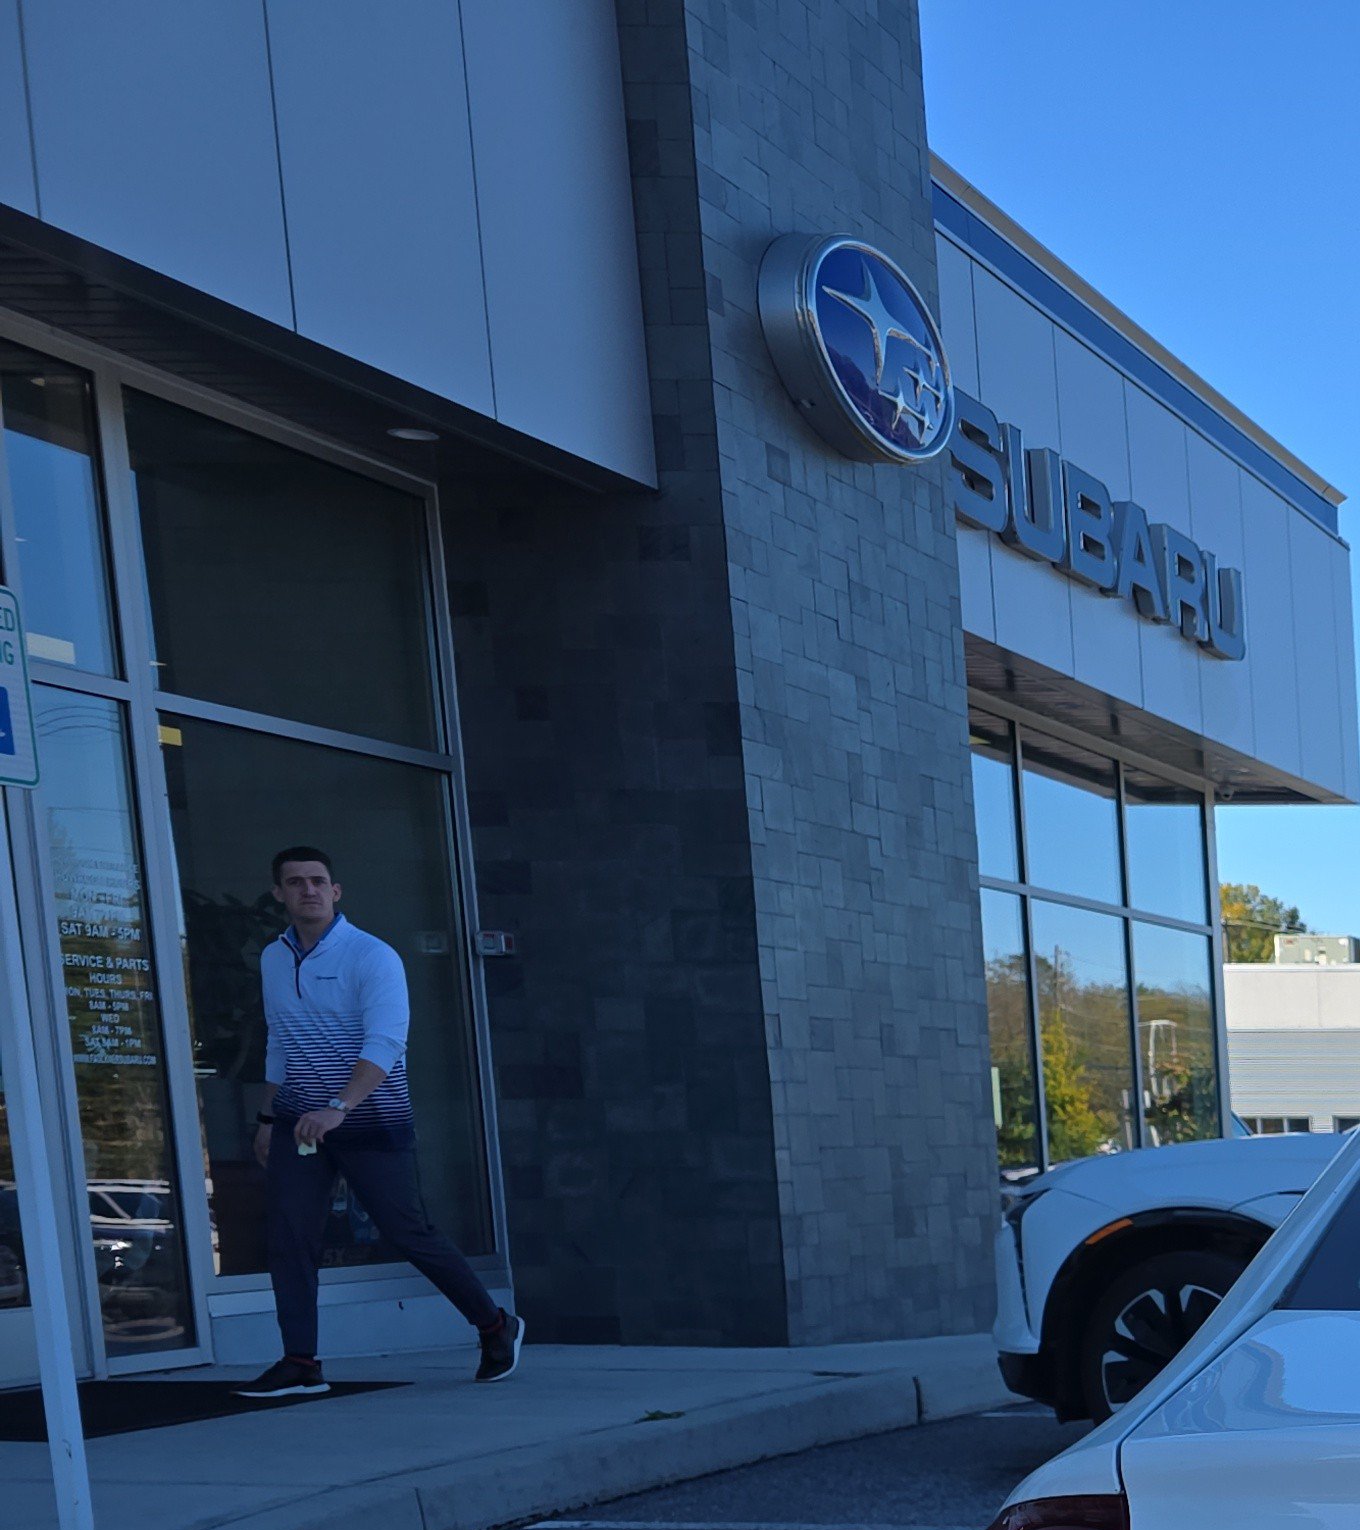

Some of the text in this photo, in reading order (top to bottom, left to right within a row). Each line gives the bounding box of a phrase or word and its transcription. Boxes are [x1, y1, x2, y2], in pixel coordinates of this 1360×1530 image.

[951, 386, 1246, 660] SUBARU
[61, 921, 82, 935] SAT
[84, 923, 108, 938] 9AM
[117, 926, 140, 941] 5PM
[106, 955, 114, 969] &
[115, 957, 149, 971] PARTS
[89, 972, 122, 985] HOURS
